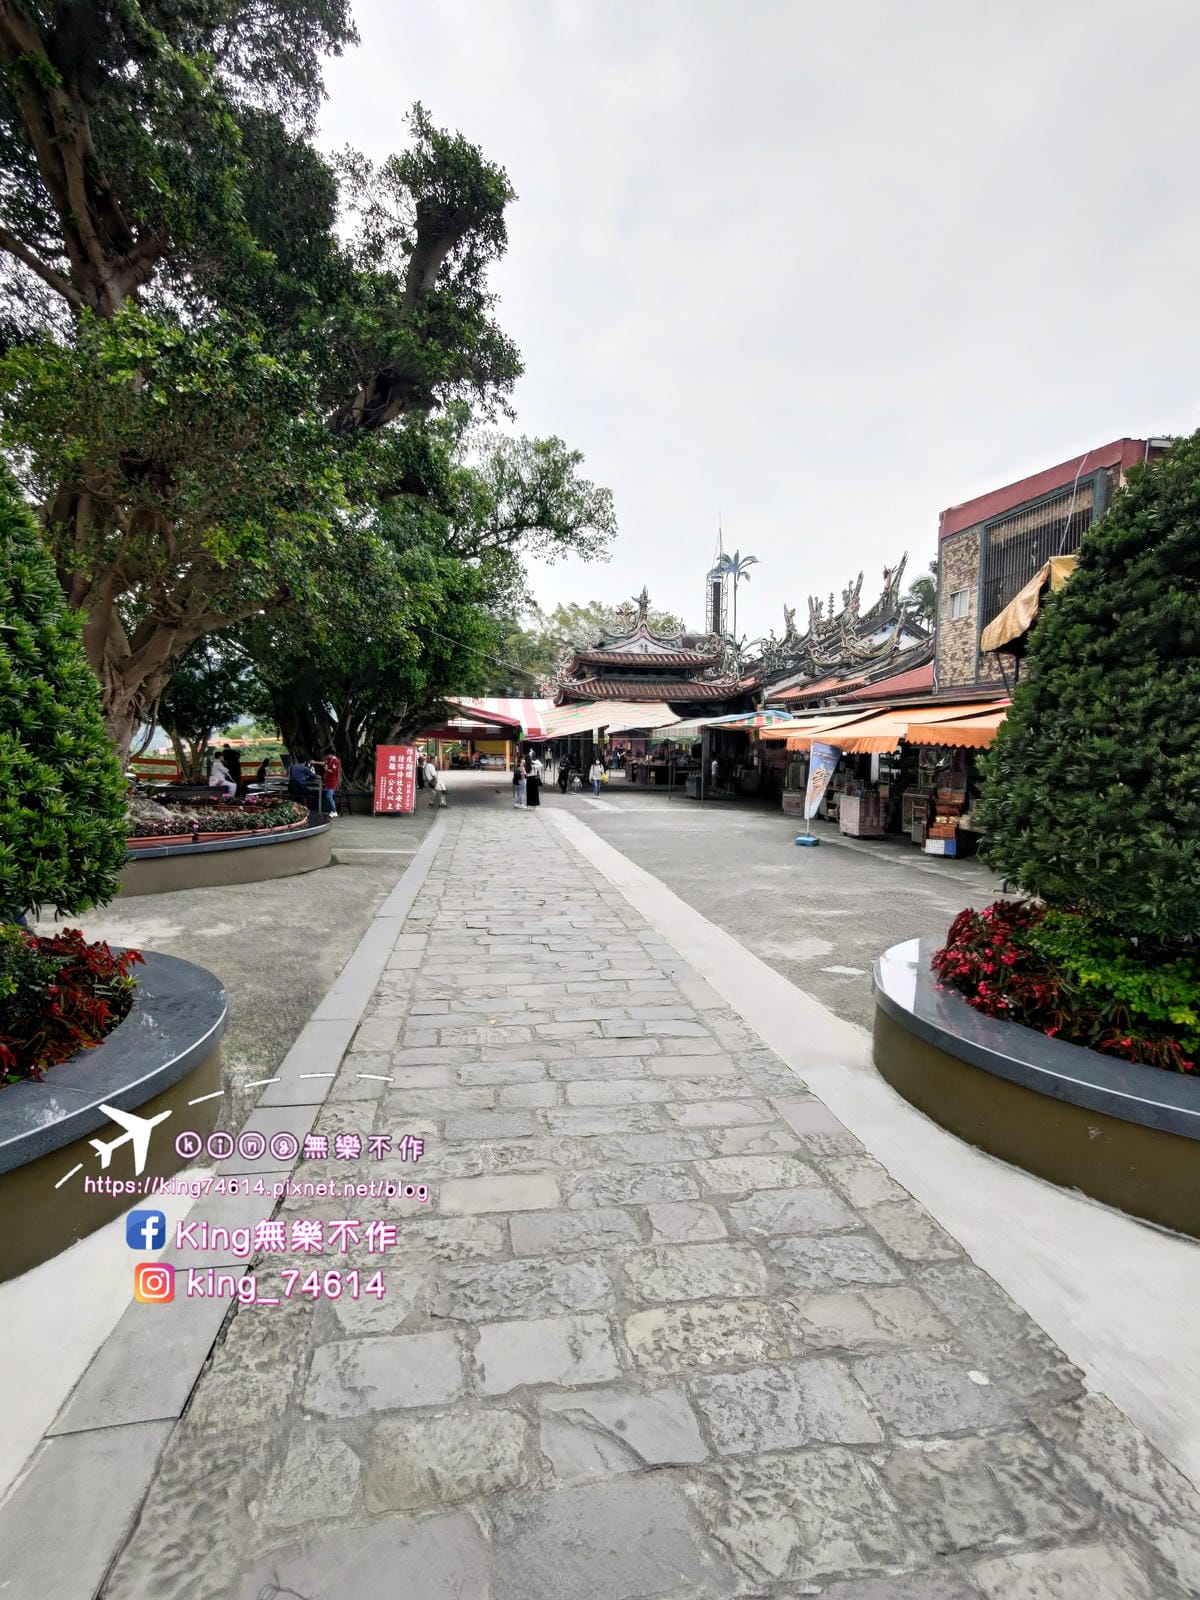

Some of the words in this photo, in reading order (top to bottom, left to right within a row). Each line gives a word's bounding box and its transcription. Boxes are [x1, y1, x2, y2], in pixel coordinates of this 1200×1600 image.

[387, 755, 397, 810] 距離一公尺以上
[395, 755, 405, 810] 請保持社交安全
